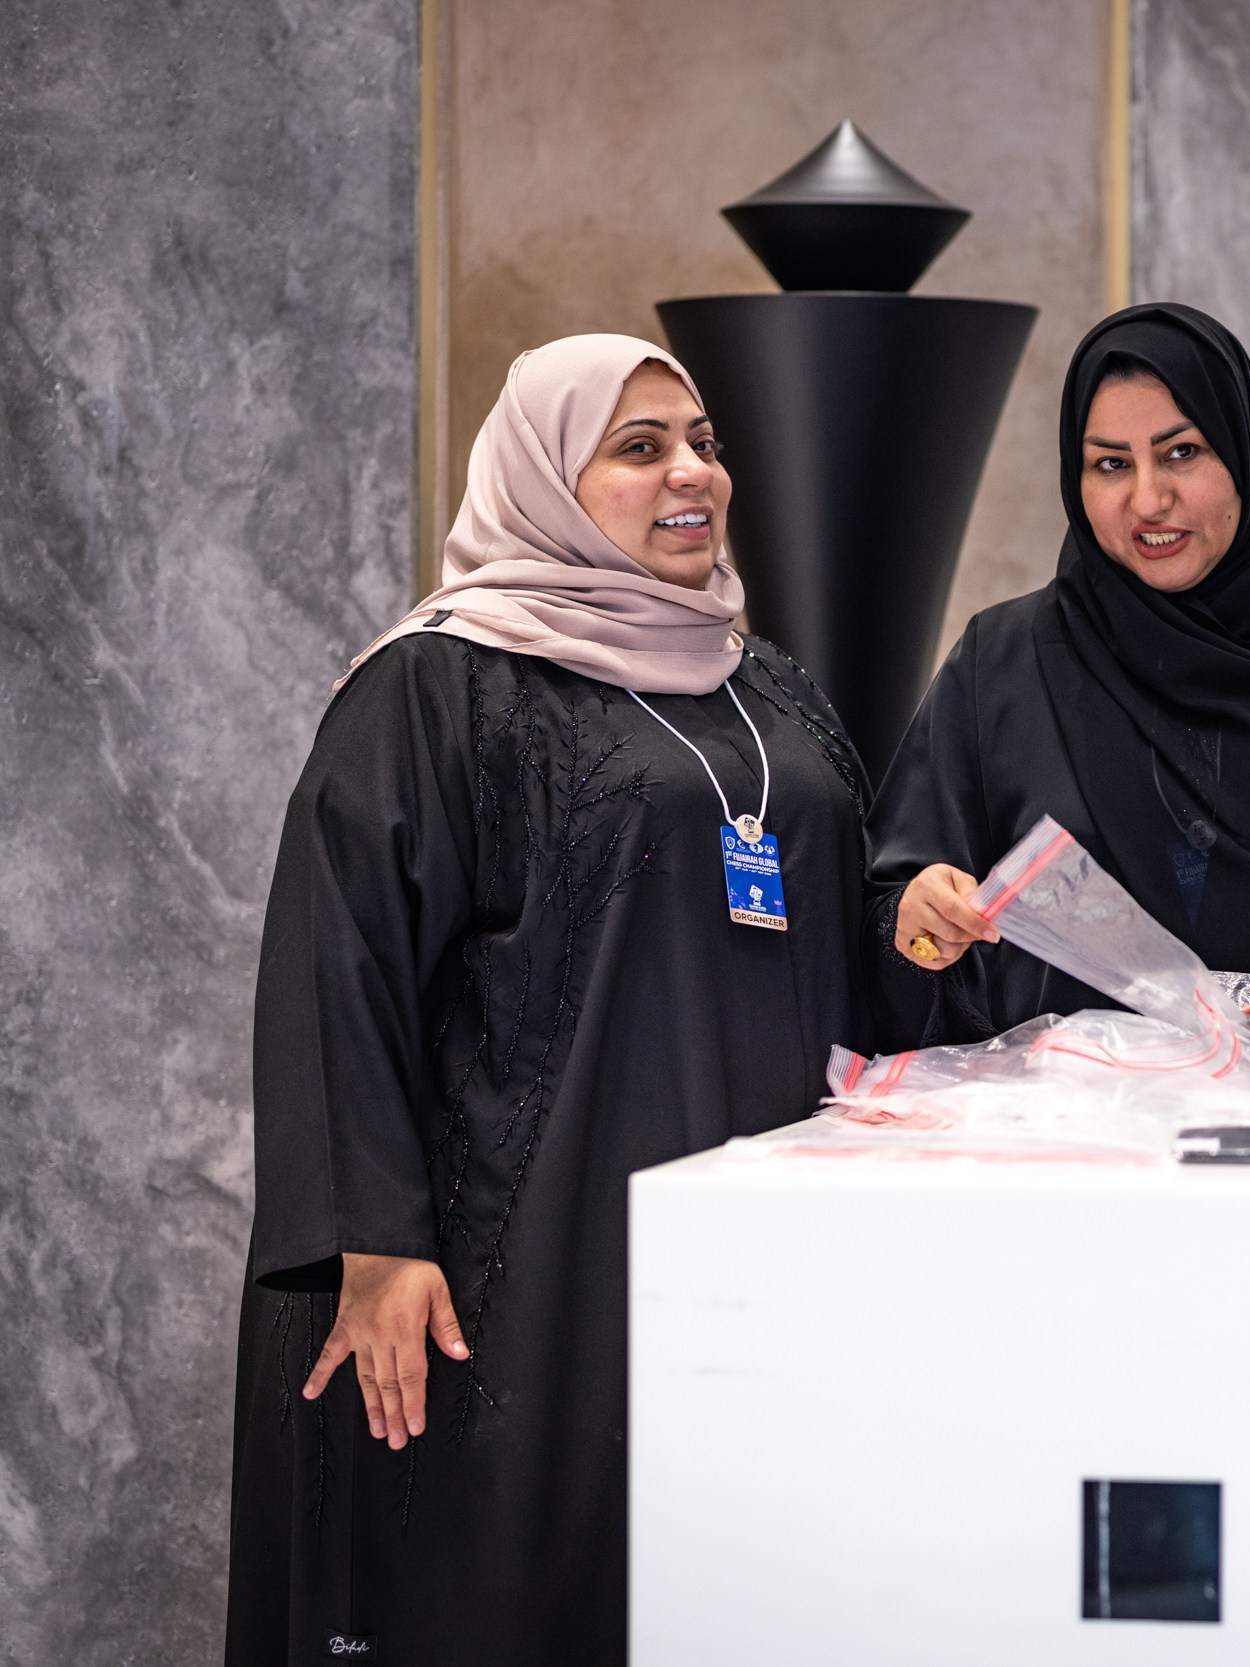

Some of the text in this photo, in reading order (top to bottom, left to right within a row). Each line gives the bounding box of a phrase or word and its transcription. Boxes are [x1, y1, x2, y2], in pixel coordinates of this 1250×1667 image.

[726, 859, 742, 867] CHESS
[742, 862, 780, 874] CHAMPIONSHIP
[758, 856, 779, 869] GLOBAL
[734, 911, 785, 928] ORGANIZER
